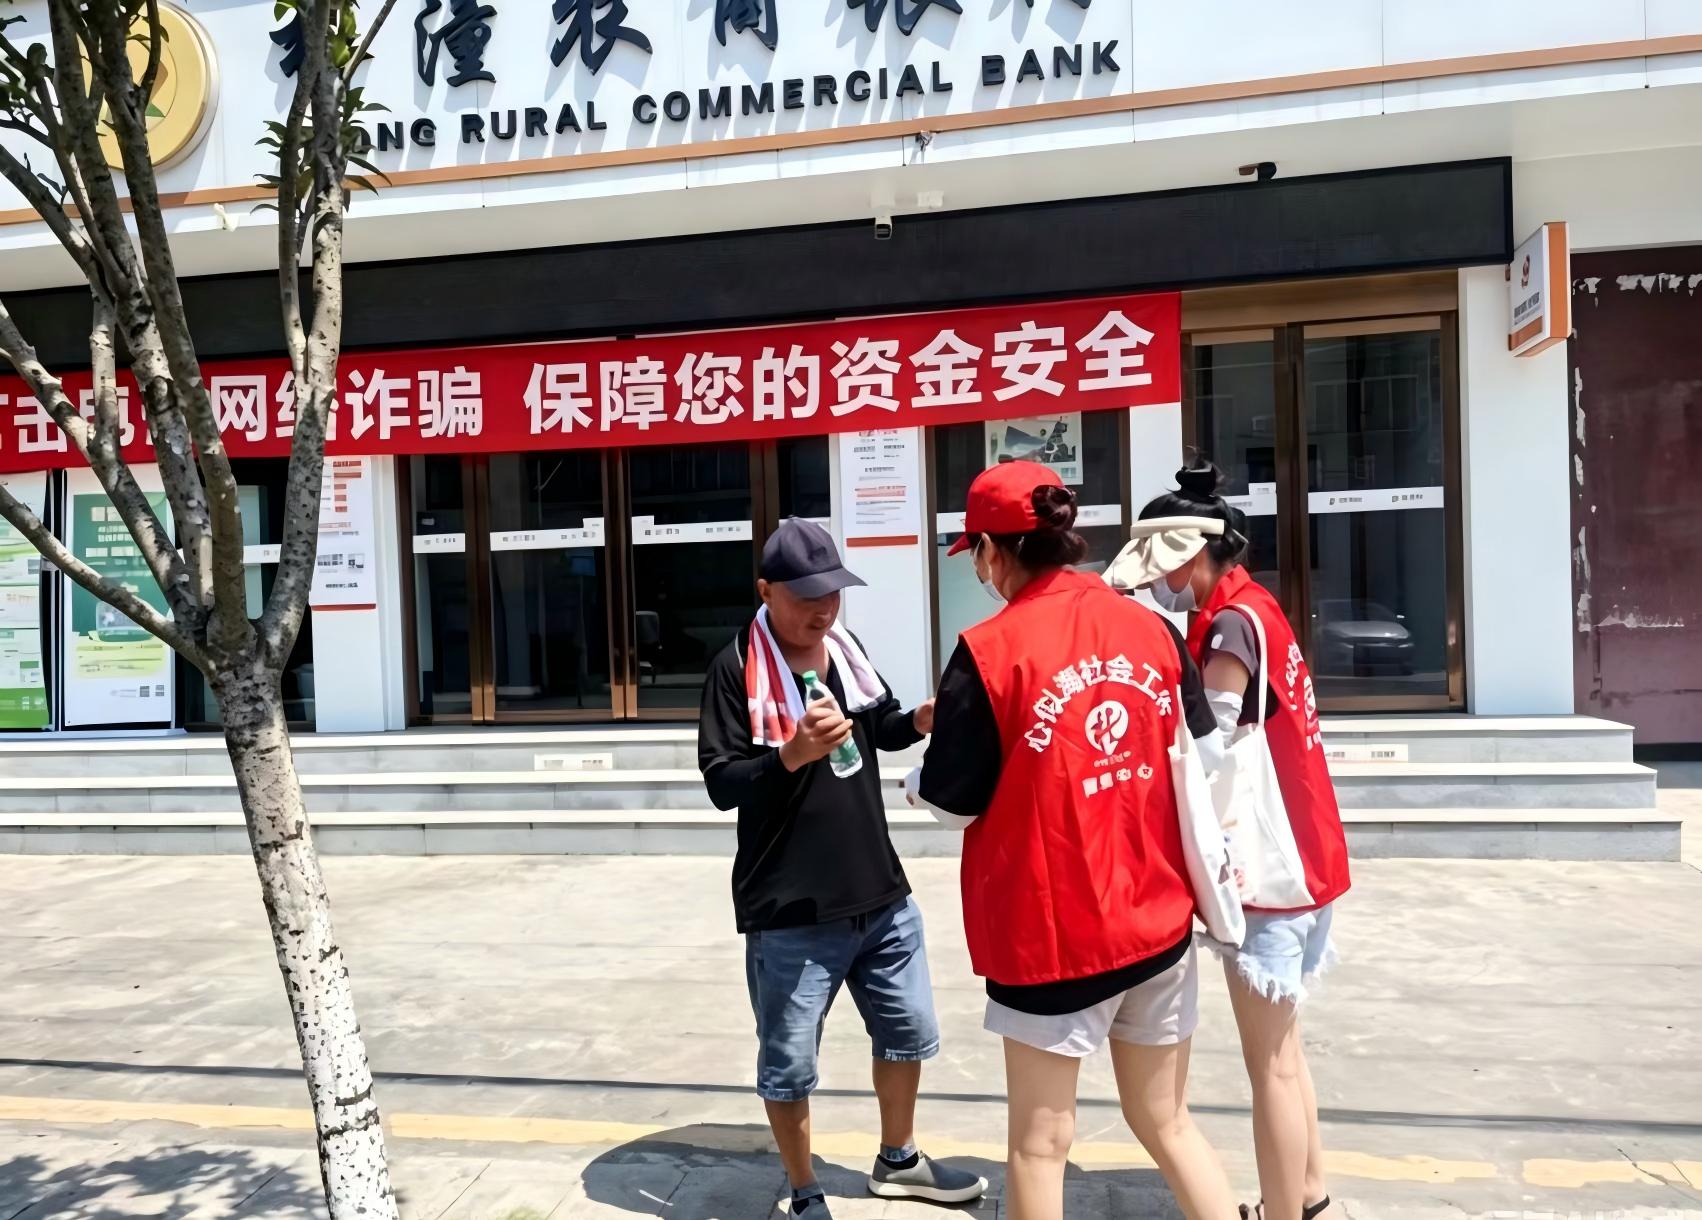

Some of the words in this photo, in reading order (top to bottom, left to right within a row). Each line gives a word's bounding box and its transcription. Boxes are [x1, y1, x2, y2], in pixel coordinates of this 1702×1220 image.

[460, 101, 608, 144] RURAL
[632, 60, 954, 125] COMMERCIAL
[981, 39, 1121, 87] BANK
[523, 309, 1155, 436] 保障您的资金安全
